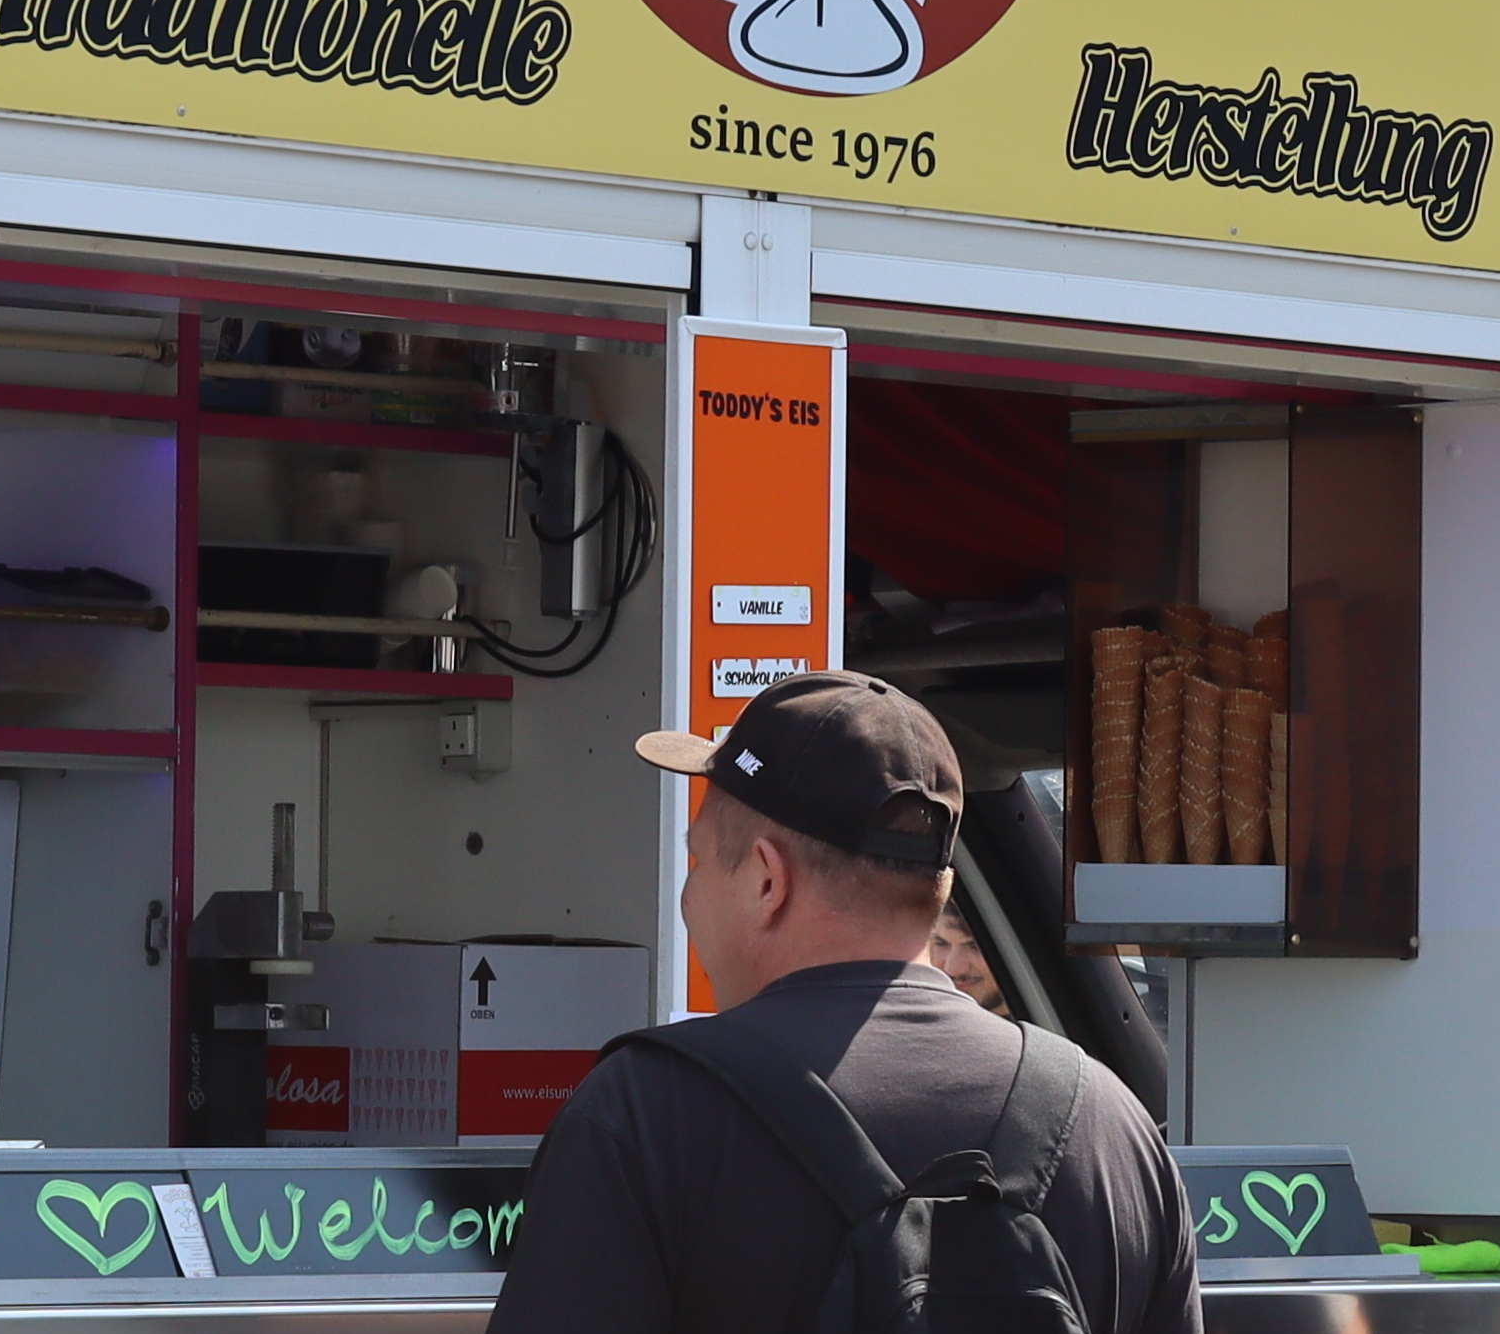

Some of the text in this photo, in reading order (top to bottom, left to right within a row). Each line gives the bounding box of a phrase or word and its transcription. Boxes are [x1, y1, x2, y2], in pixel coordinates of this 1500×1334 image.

[688, 105, 937, 183] since 1976
[1066, 42, 1493, 243] Herstellung
[699, 390, 820, 427] TODDY'S EIS
[739, 600, 784, 616] VANILLE
[734, 748, 764, 777] NIKE
[470, 1009, 496, 1020] OBEN
